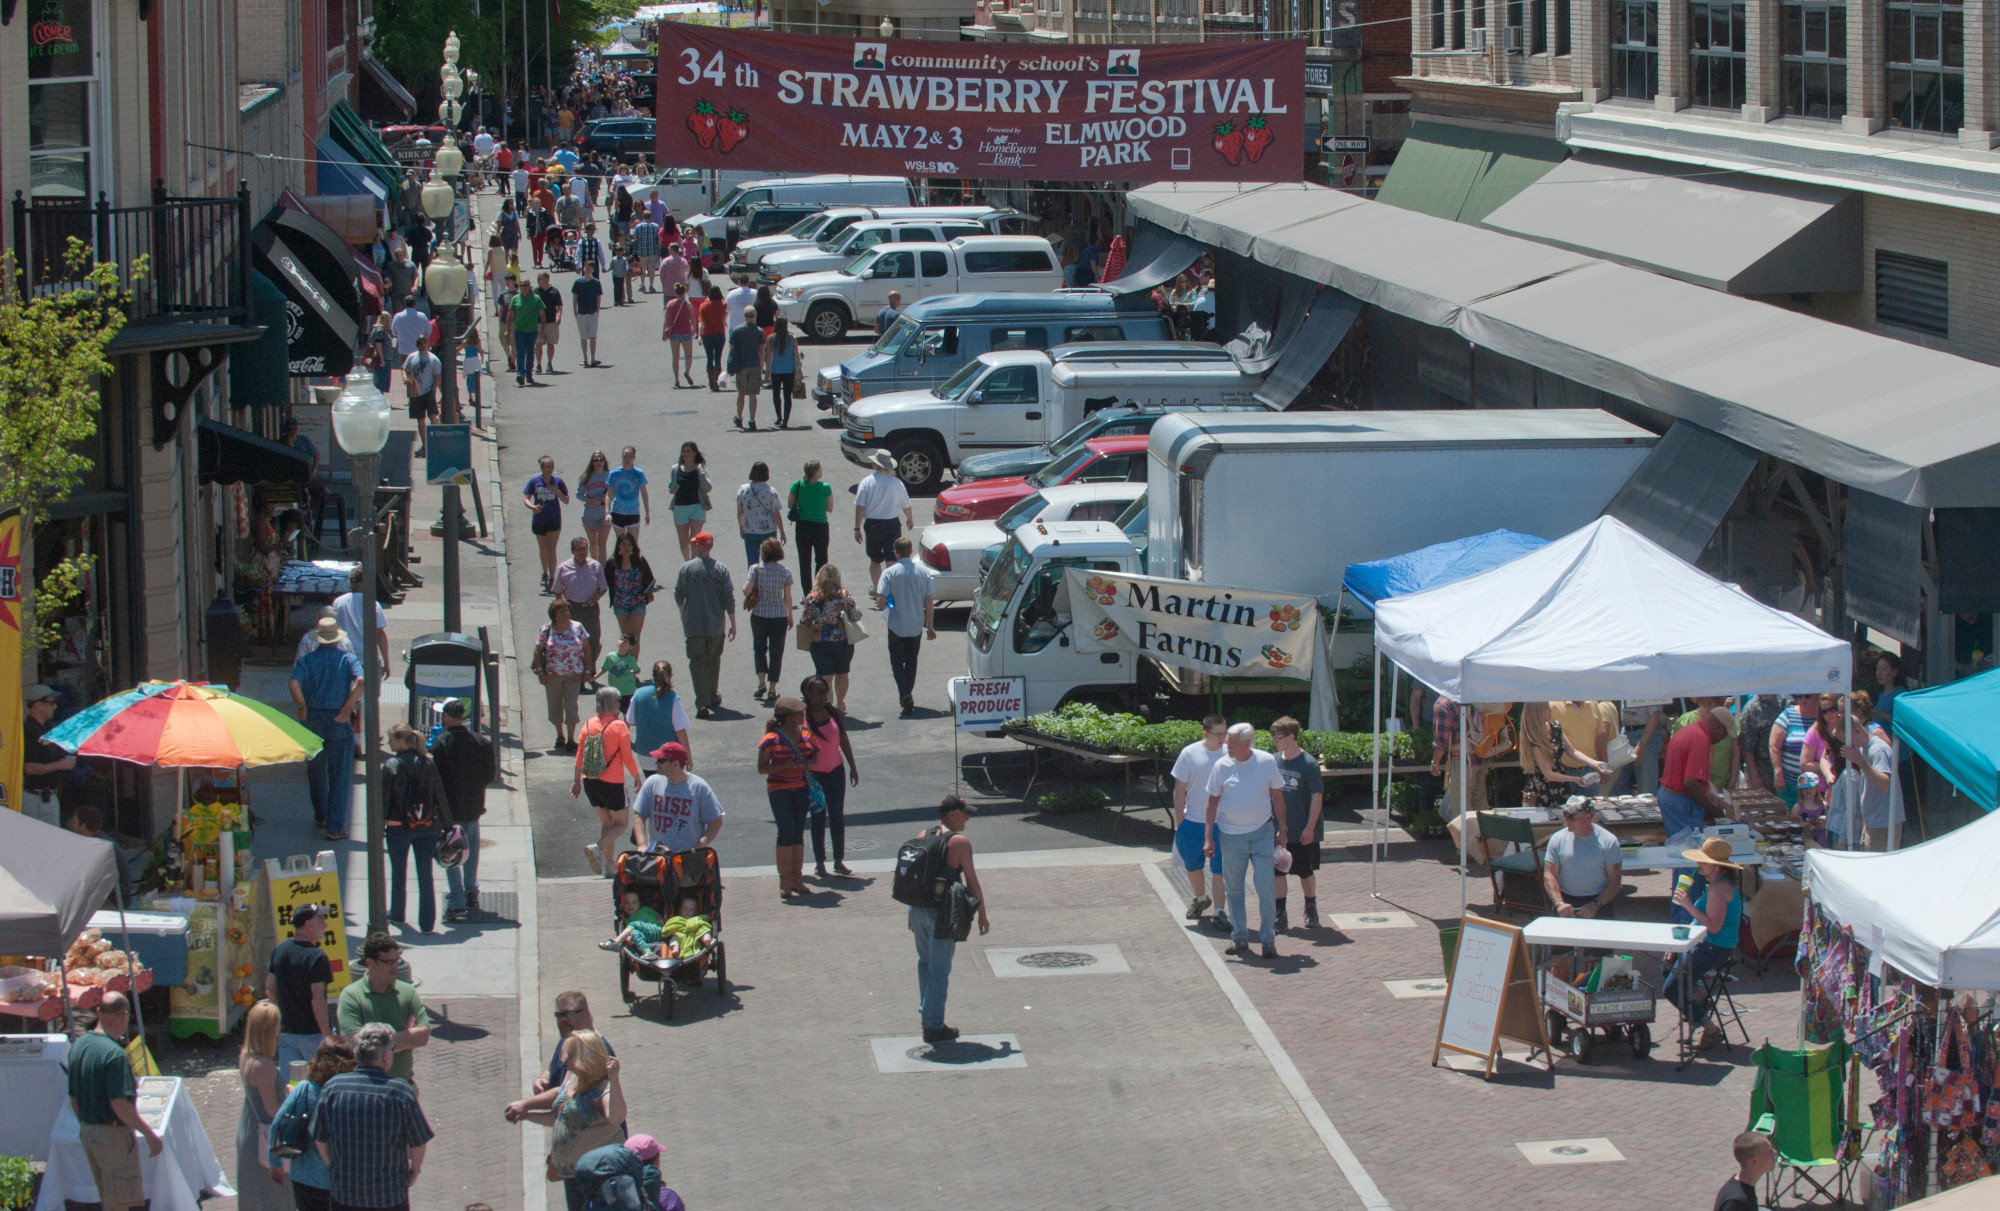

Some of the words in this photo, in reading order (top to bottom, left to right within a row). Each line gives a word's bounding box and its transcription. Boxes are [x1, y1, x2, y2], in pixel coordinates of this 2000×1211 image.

[33, 21, 73, 45] CLOVER
[30, 45, 45, 57] ICE
[48, 42, 79, 55] CREAM
[678, 48, 726, 86] 34
[735, 63, 759, 87] th
[891, 54, 1011, 74] community
[1018, 56, 1099, 72] school's
[777, 70, 1069, 114] STRAWBERRY
[1084, 79, 1287, 114] FESTIVAL
[840, 123, 911, 149] MAY
[913, 126, 928, 149] 2
[929, 131, 943, 145] &
[948, 127, 963, 150] 3
[1013, 127, 1021, 135] by
[1045, 116, 1187, 145] ELMWOOD
[978, 142, 1037, 154] HomeTown
[1335, 140, 1348, 148] ONE
[1350, 140, 1365, 148] WAY
[397, 151, 420, 159] KIRK
[993, 153, 1022, 167] Bank
[1080, 141, 1152, 168] PARK
[905, 161, 936, 171] WSLS
[937, 162, 954, 173] 10
[1343, 163, 1354, 178] STOP
[435, 429, 454, 437] Elmwood
[1125, 582, 1257, 628] Martin
[1136, 620, 1242, 668] Farms
[418, 669, 440, 678] make
[449, 672, 473, 682] yours
[969, 682, 1010, 697] FRESH
[960, 698, 1021, 714] PRODUCE
[653, 794, 693, 816] RISE
[653, 814, 674, 833] UP
[289, 877, 322, 899] Fresh
[1464, 938, 1496, 962] EBT
[1459, 978, 1503, 1006] CREDIT
[1592, 1004, 1619, 1013] TRACIE
[1622, 1002, 1651, 1011] HUGHES
[1466, 1017, 1489, 1038] tokens
